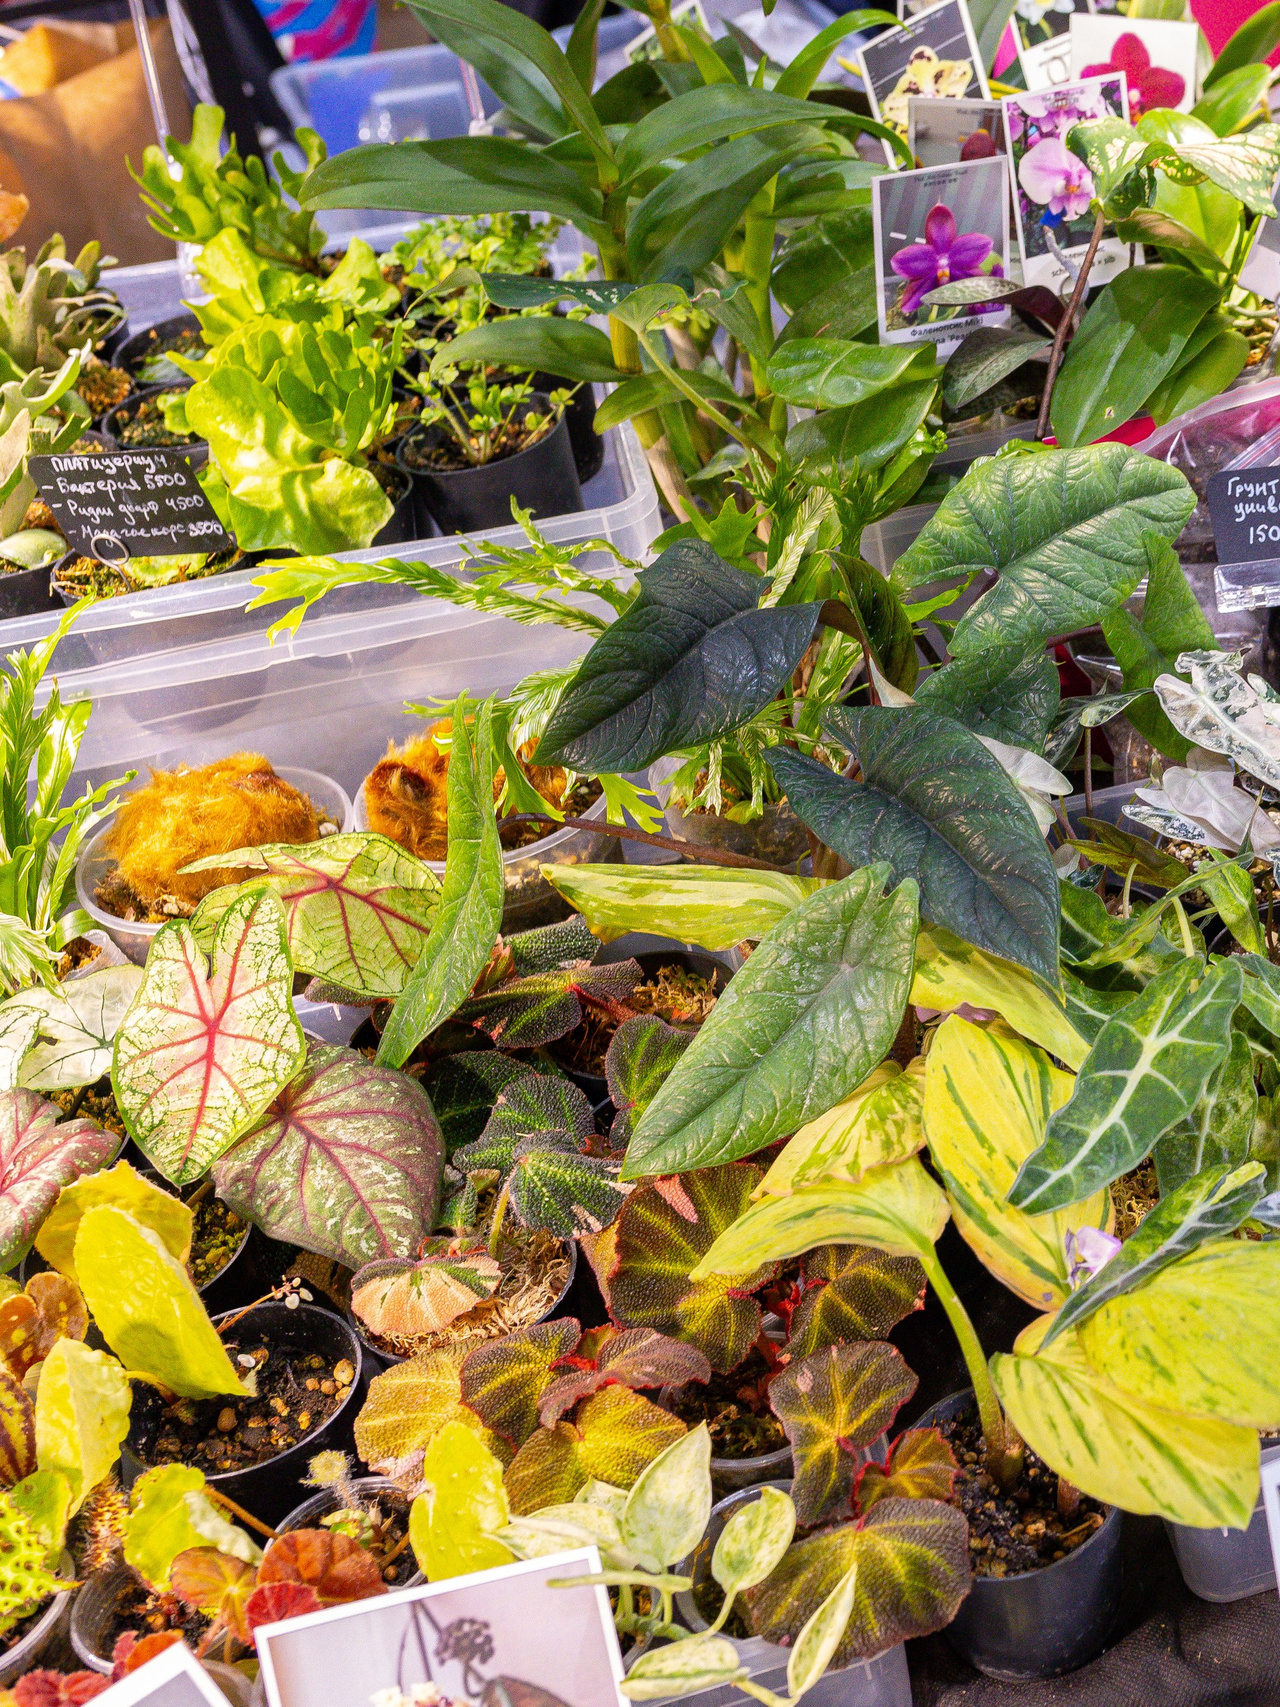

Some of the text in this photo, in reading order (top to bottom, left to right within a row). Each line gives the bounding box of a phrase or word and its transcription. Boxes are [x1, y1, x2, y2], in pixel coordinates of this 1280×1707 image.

[910, 322, 964, 337] Фаленопсис
[143, 473, 187, 490] 5500
[1227, 476, 1280, 498] Грунт
[165, 494, 205, 511] 4500
[1249, 524, 1280, 545] 150
